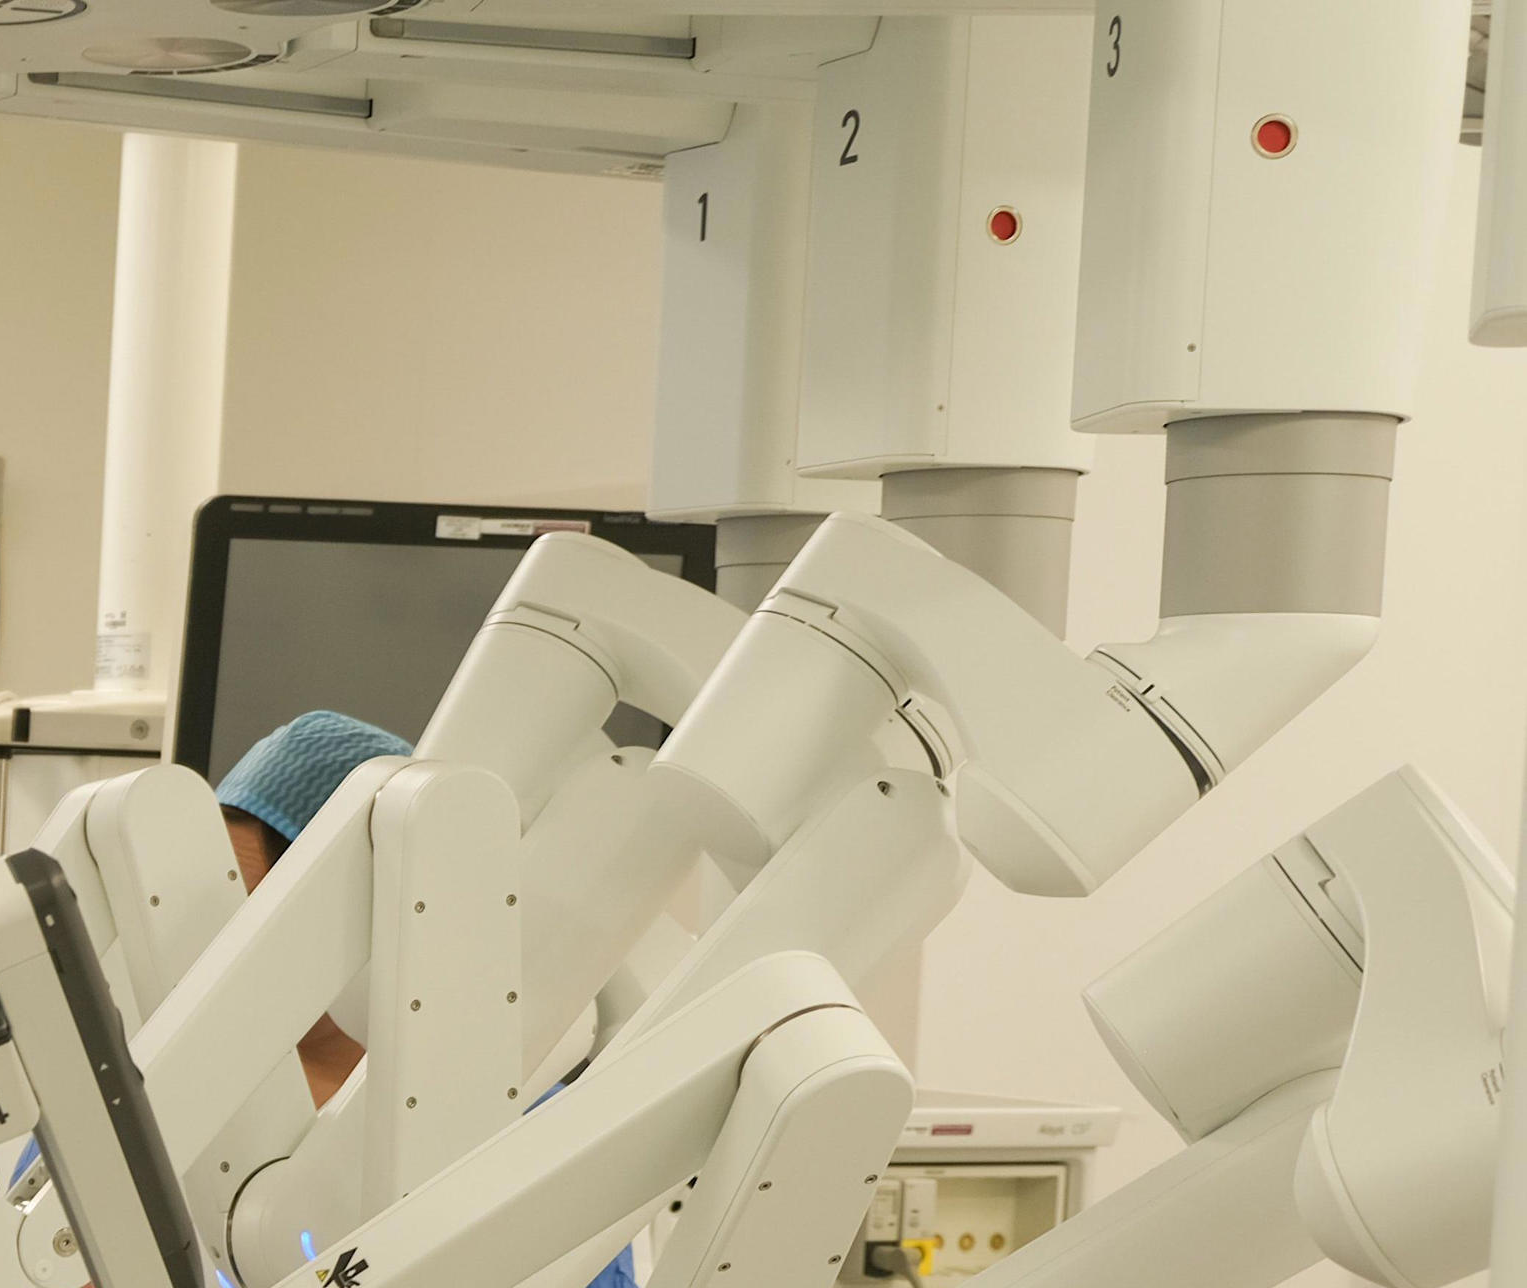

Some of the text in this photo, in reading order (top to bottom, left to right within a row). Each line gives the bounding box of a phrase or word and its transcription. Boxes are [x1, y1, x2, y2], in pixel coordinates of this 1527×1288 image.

[1106, 15, 1122, 78] 3
[839, 109, 860, 166] 2
[698, 192, 709, 242] 1
